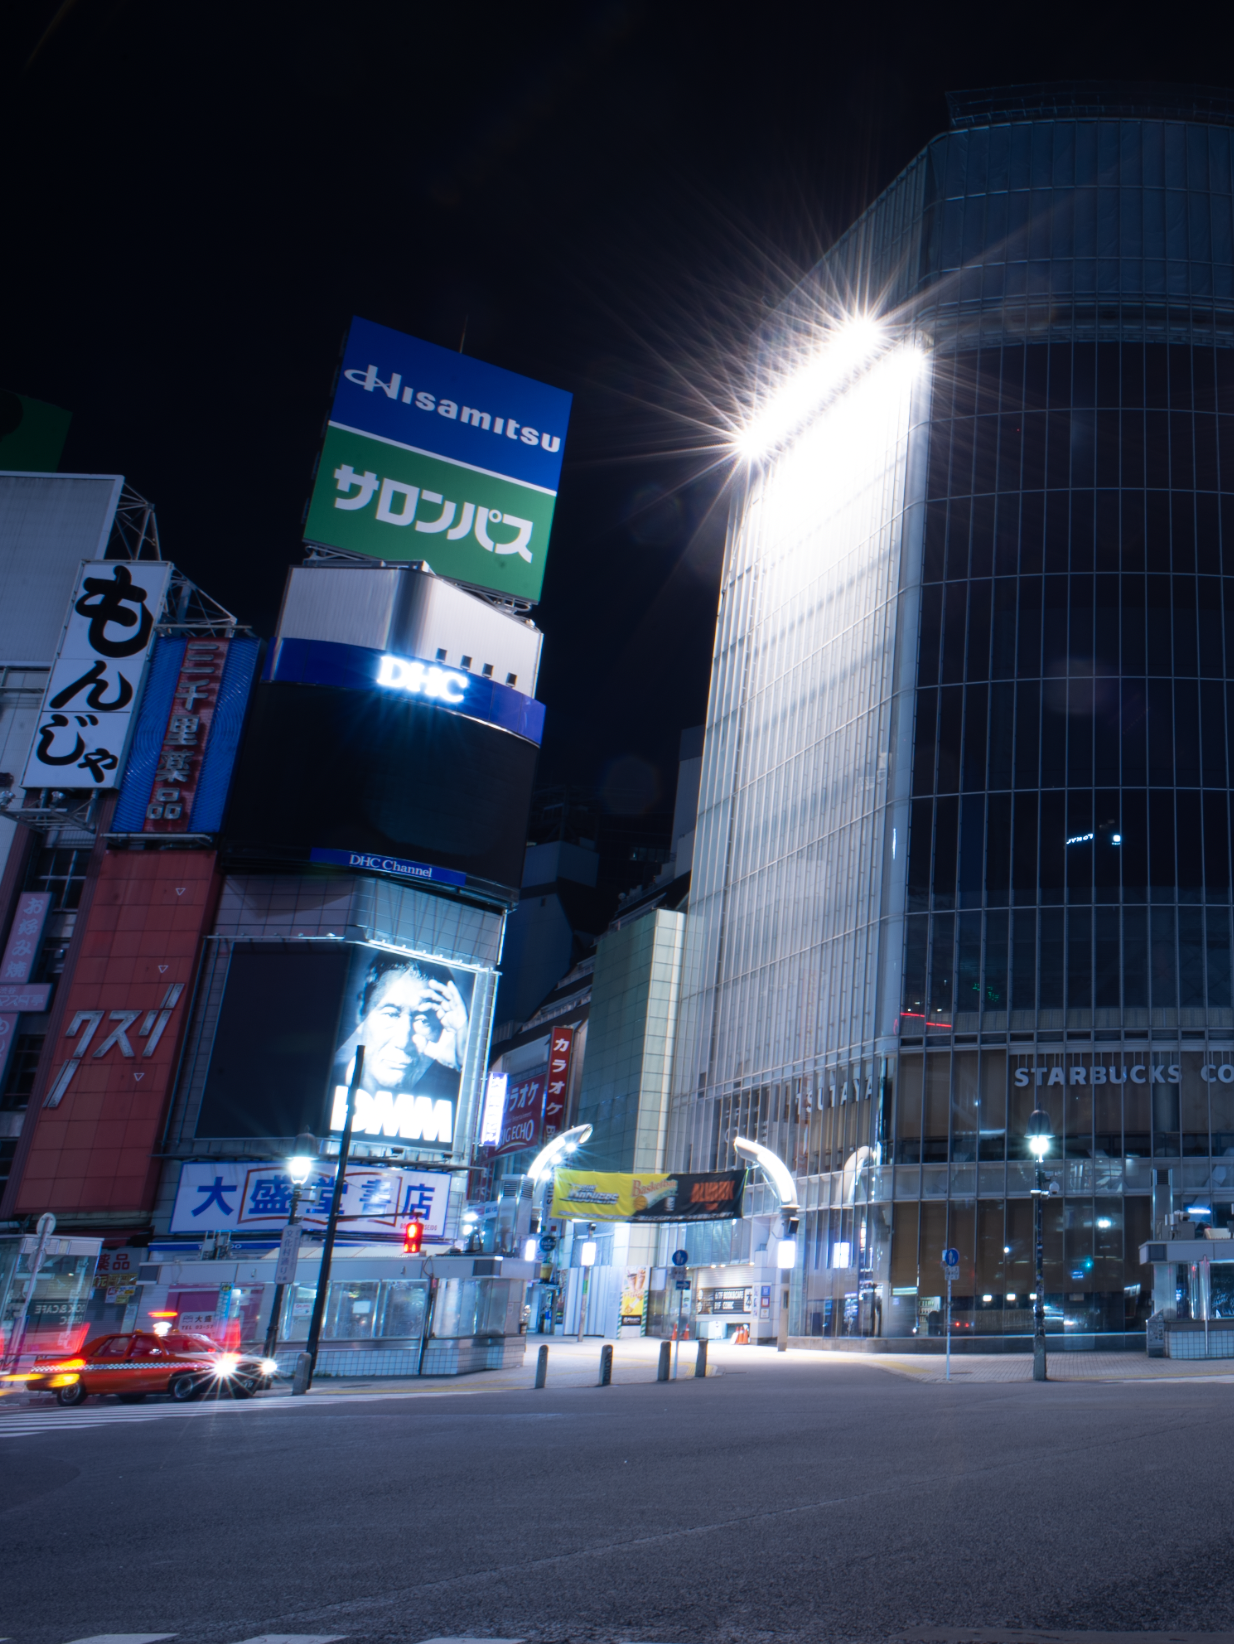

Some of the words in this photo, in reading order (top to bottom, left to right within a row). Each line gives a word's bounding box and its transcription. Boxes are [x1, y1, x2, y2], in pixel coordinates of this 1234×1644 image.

[344, 364, 561, 453] Hisamitsu
[333, 464, 534, 563] サロンパス
[36, 565, 154, 783] もんじゃ
[377, 655, 468, 703] DHC
[146, 642, 219, 820] 三千里薬品
[350, 854, 381, 869] DHC
[383, 860, 432, 877] Channel
[5, 897, 44, 978] お好み焼
[546, 1038, 570, 1117] カラオケ
[1013, 1064, 1182, 1087] STARBUCKS
[512, 1119, 534, 1141] ECHO
[191, 1175, 436, 1222] 大盛堂書店
